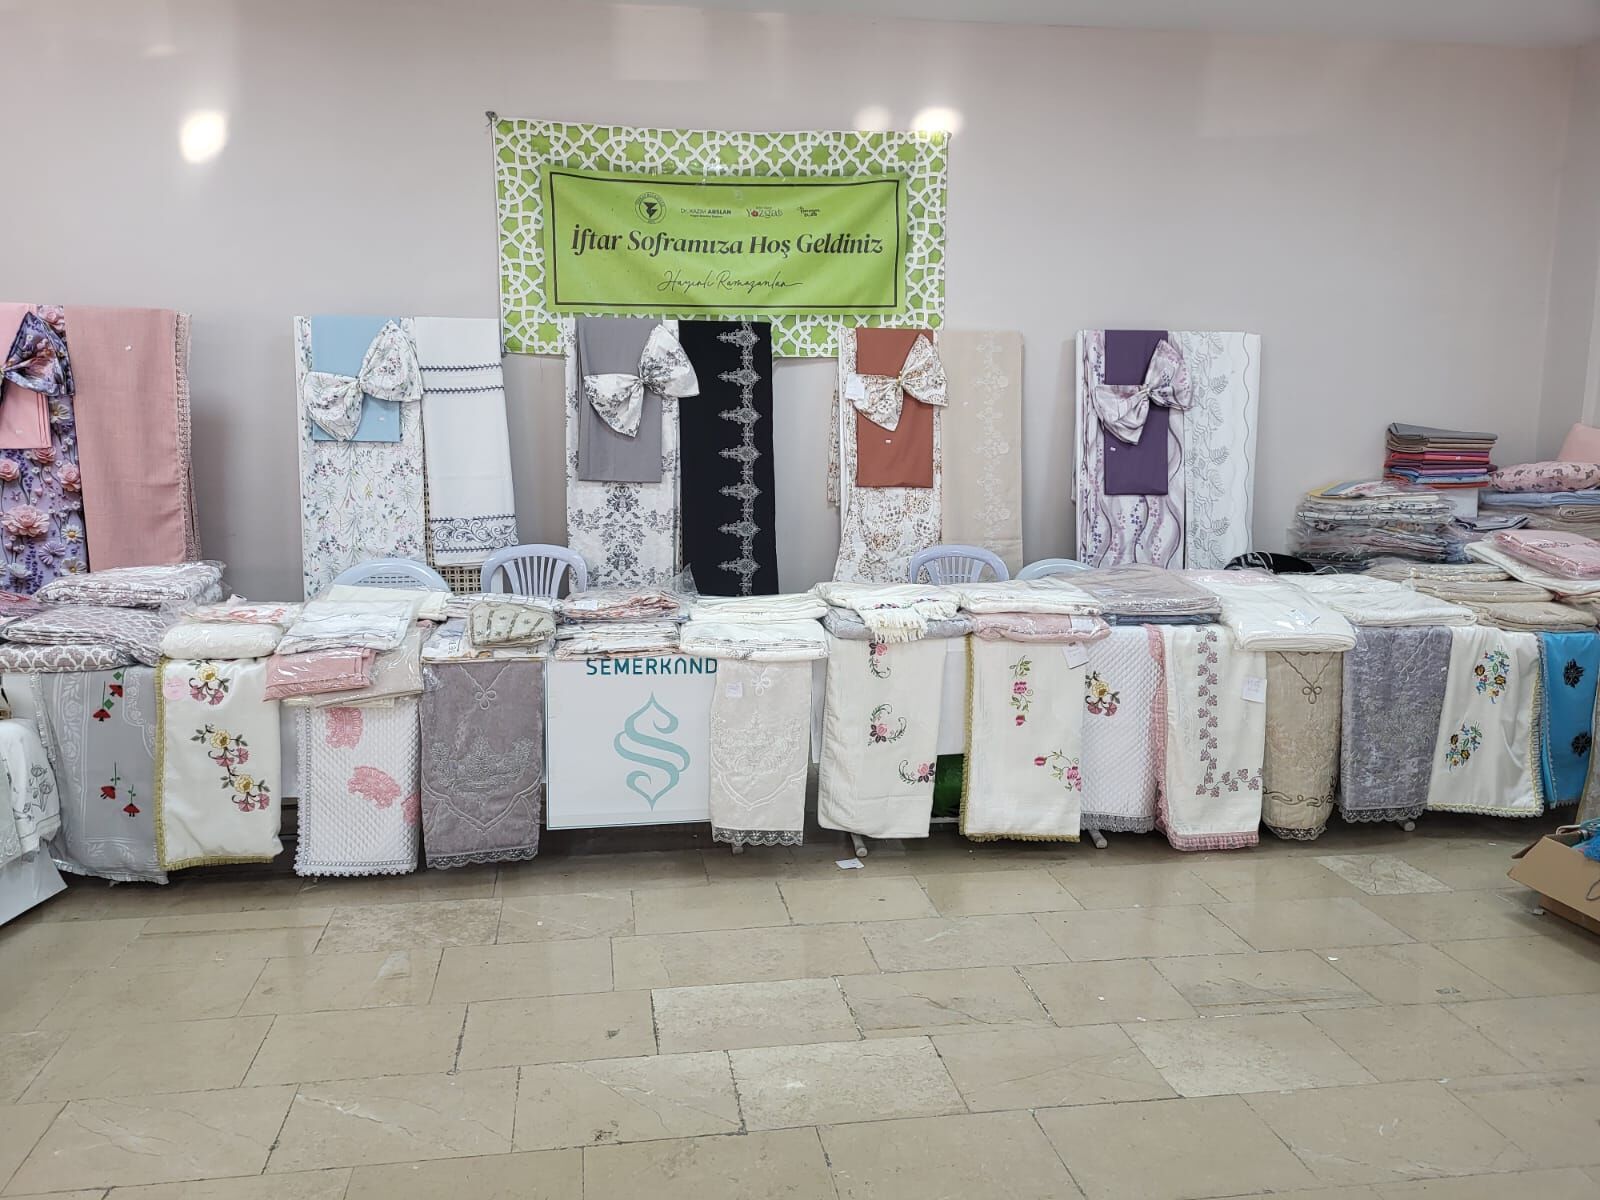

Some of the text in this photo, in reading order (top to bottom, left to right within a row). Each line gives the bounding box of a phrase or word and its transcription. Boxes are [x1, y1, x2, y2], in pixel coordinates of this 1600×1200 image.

[571, 224, 884, 258] İftar Soframıza Hoş Geldiniz
[586, 657, 718, 676] SEMERKAND
